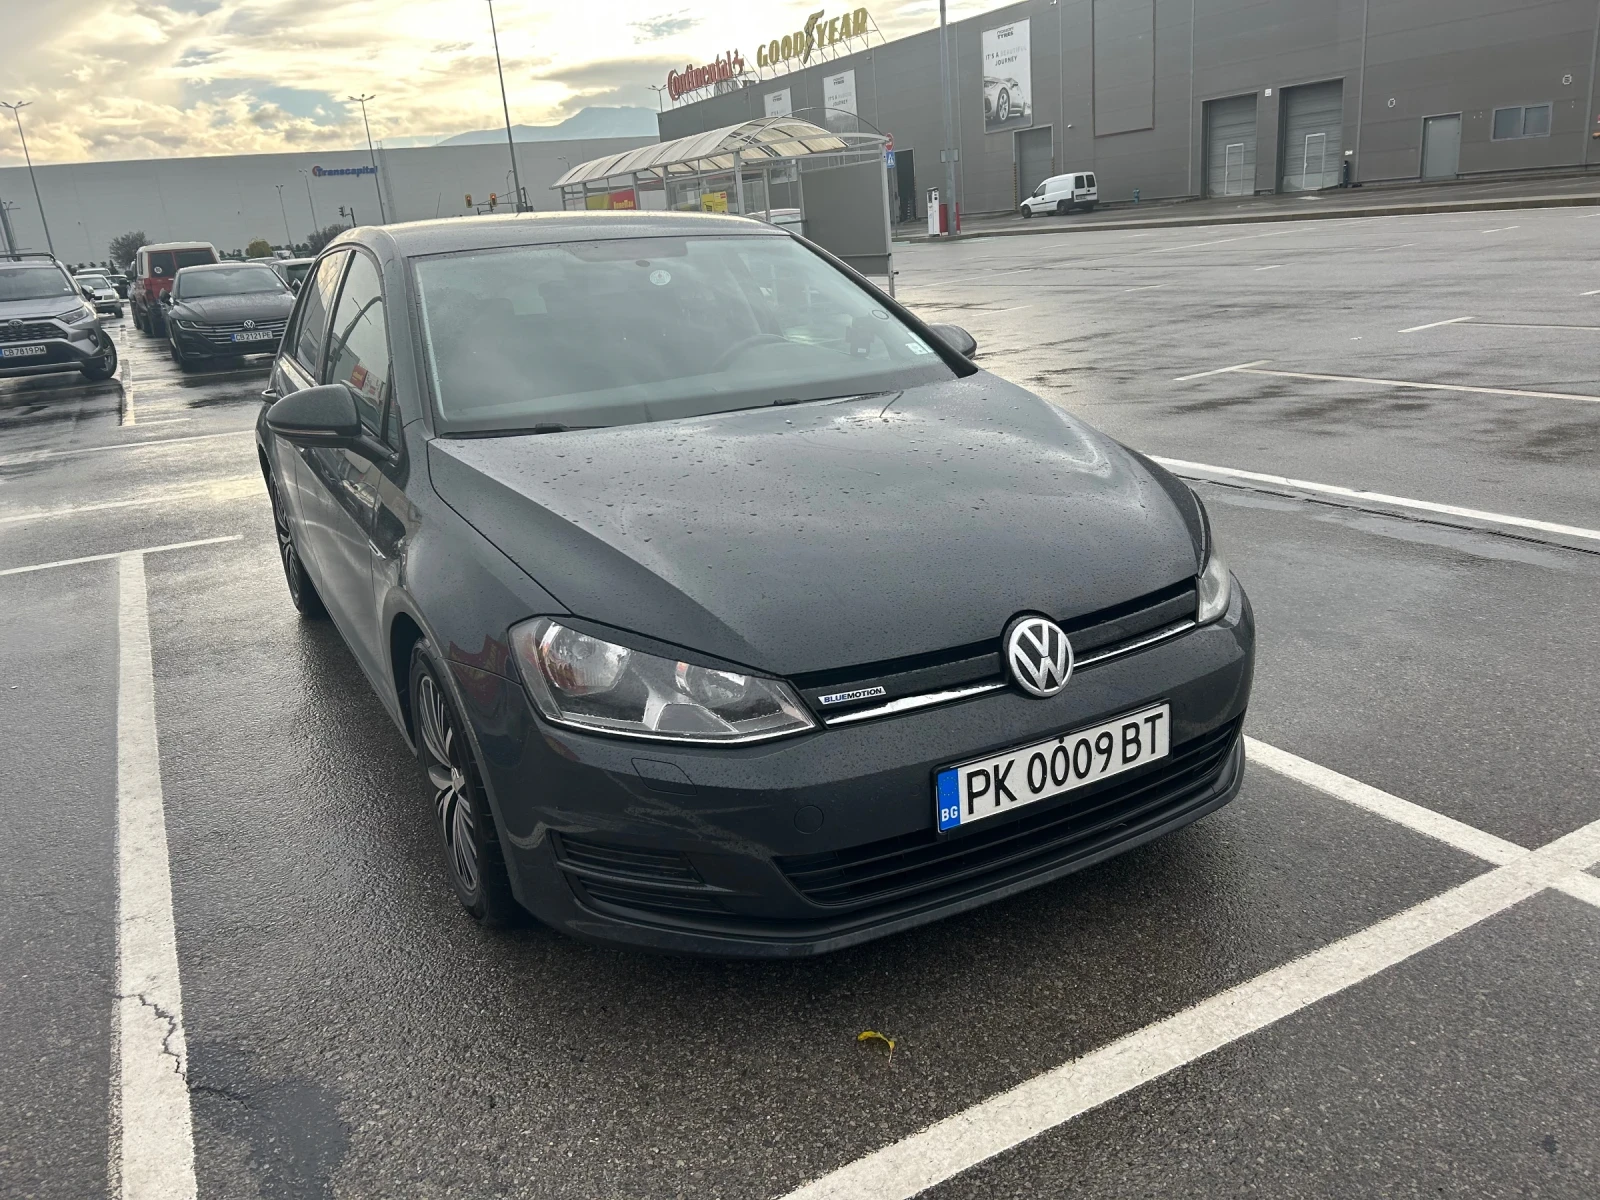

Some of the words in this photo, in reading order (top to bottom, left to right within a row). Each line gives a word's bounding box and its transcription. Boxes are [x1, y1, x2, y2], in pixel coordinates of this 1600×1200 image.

[757, 7, 868, 67] GOODYEAR
[668, 50, 734, 101] Continental
[995, 55, 1018, 66] JOURNEY
[824, 688, 882, 703] BLUEMOTION
[966, 759, 1018, 815] PK
[941, 805, 958, 822] BG
